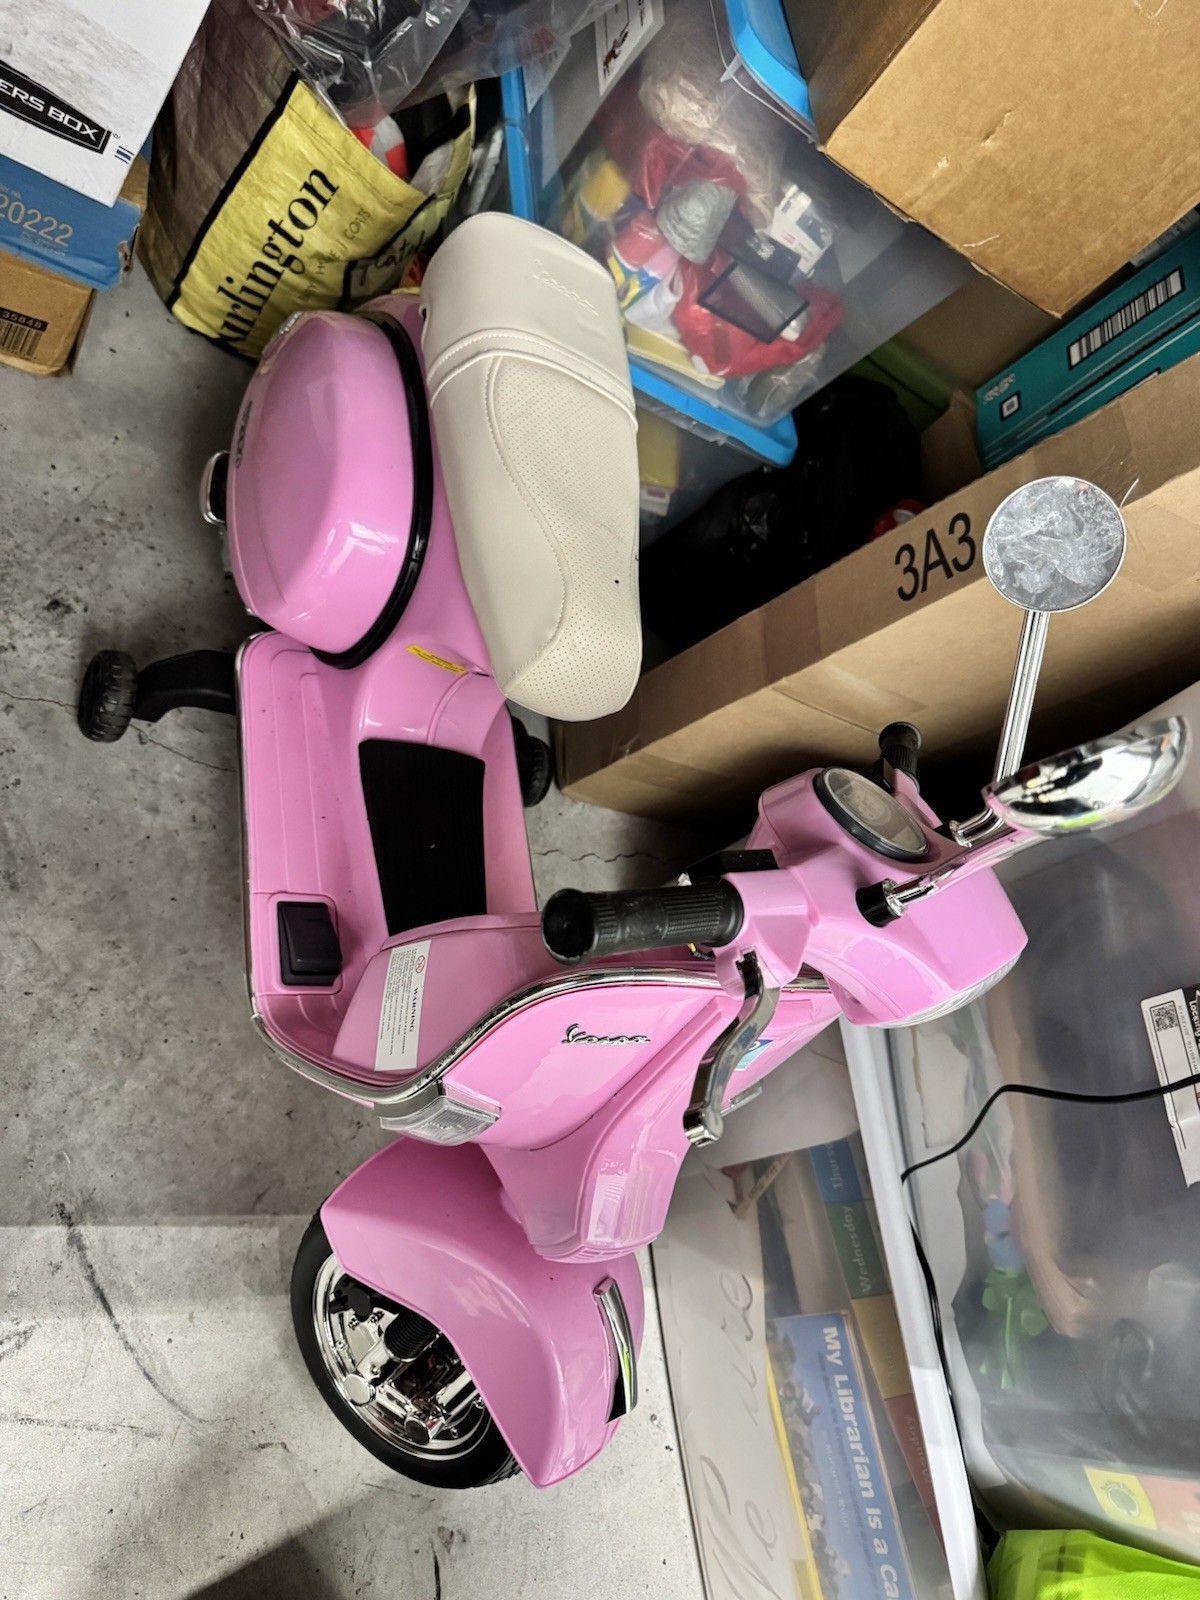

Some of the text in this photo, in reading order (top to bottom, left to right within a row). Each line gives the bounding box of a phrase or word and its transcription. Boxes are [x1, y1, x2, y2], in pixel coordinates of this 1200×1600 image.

[0, 79, 99, 142] ERS BOX
[895, 512, 976, 601] 3A3
[408, 987, 419, 1032] WARNING
[843, 1205, 872, 1292] Wednesday
[823, 1326, 843, 1366] My
[834, 1374, 875, 1498] Librarian
[866, 1507, 882, 1529] Is
[873, 1538, 889, 1555] a
